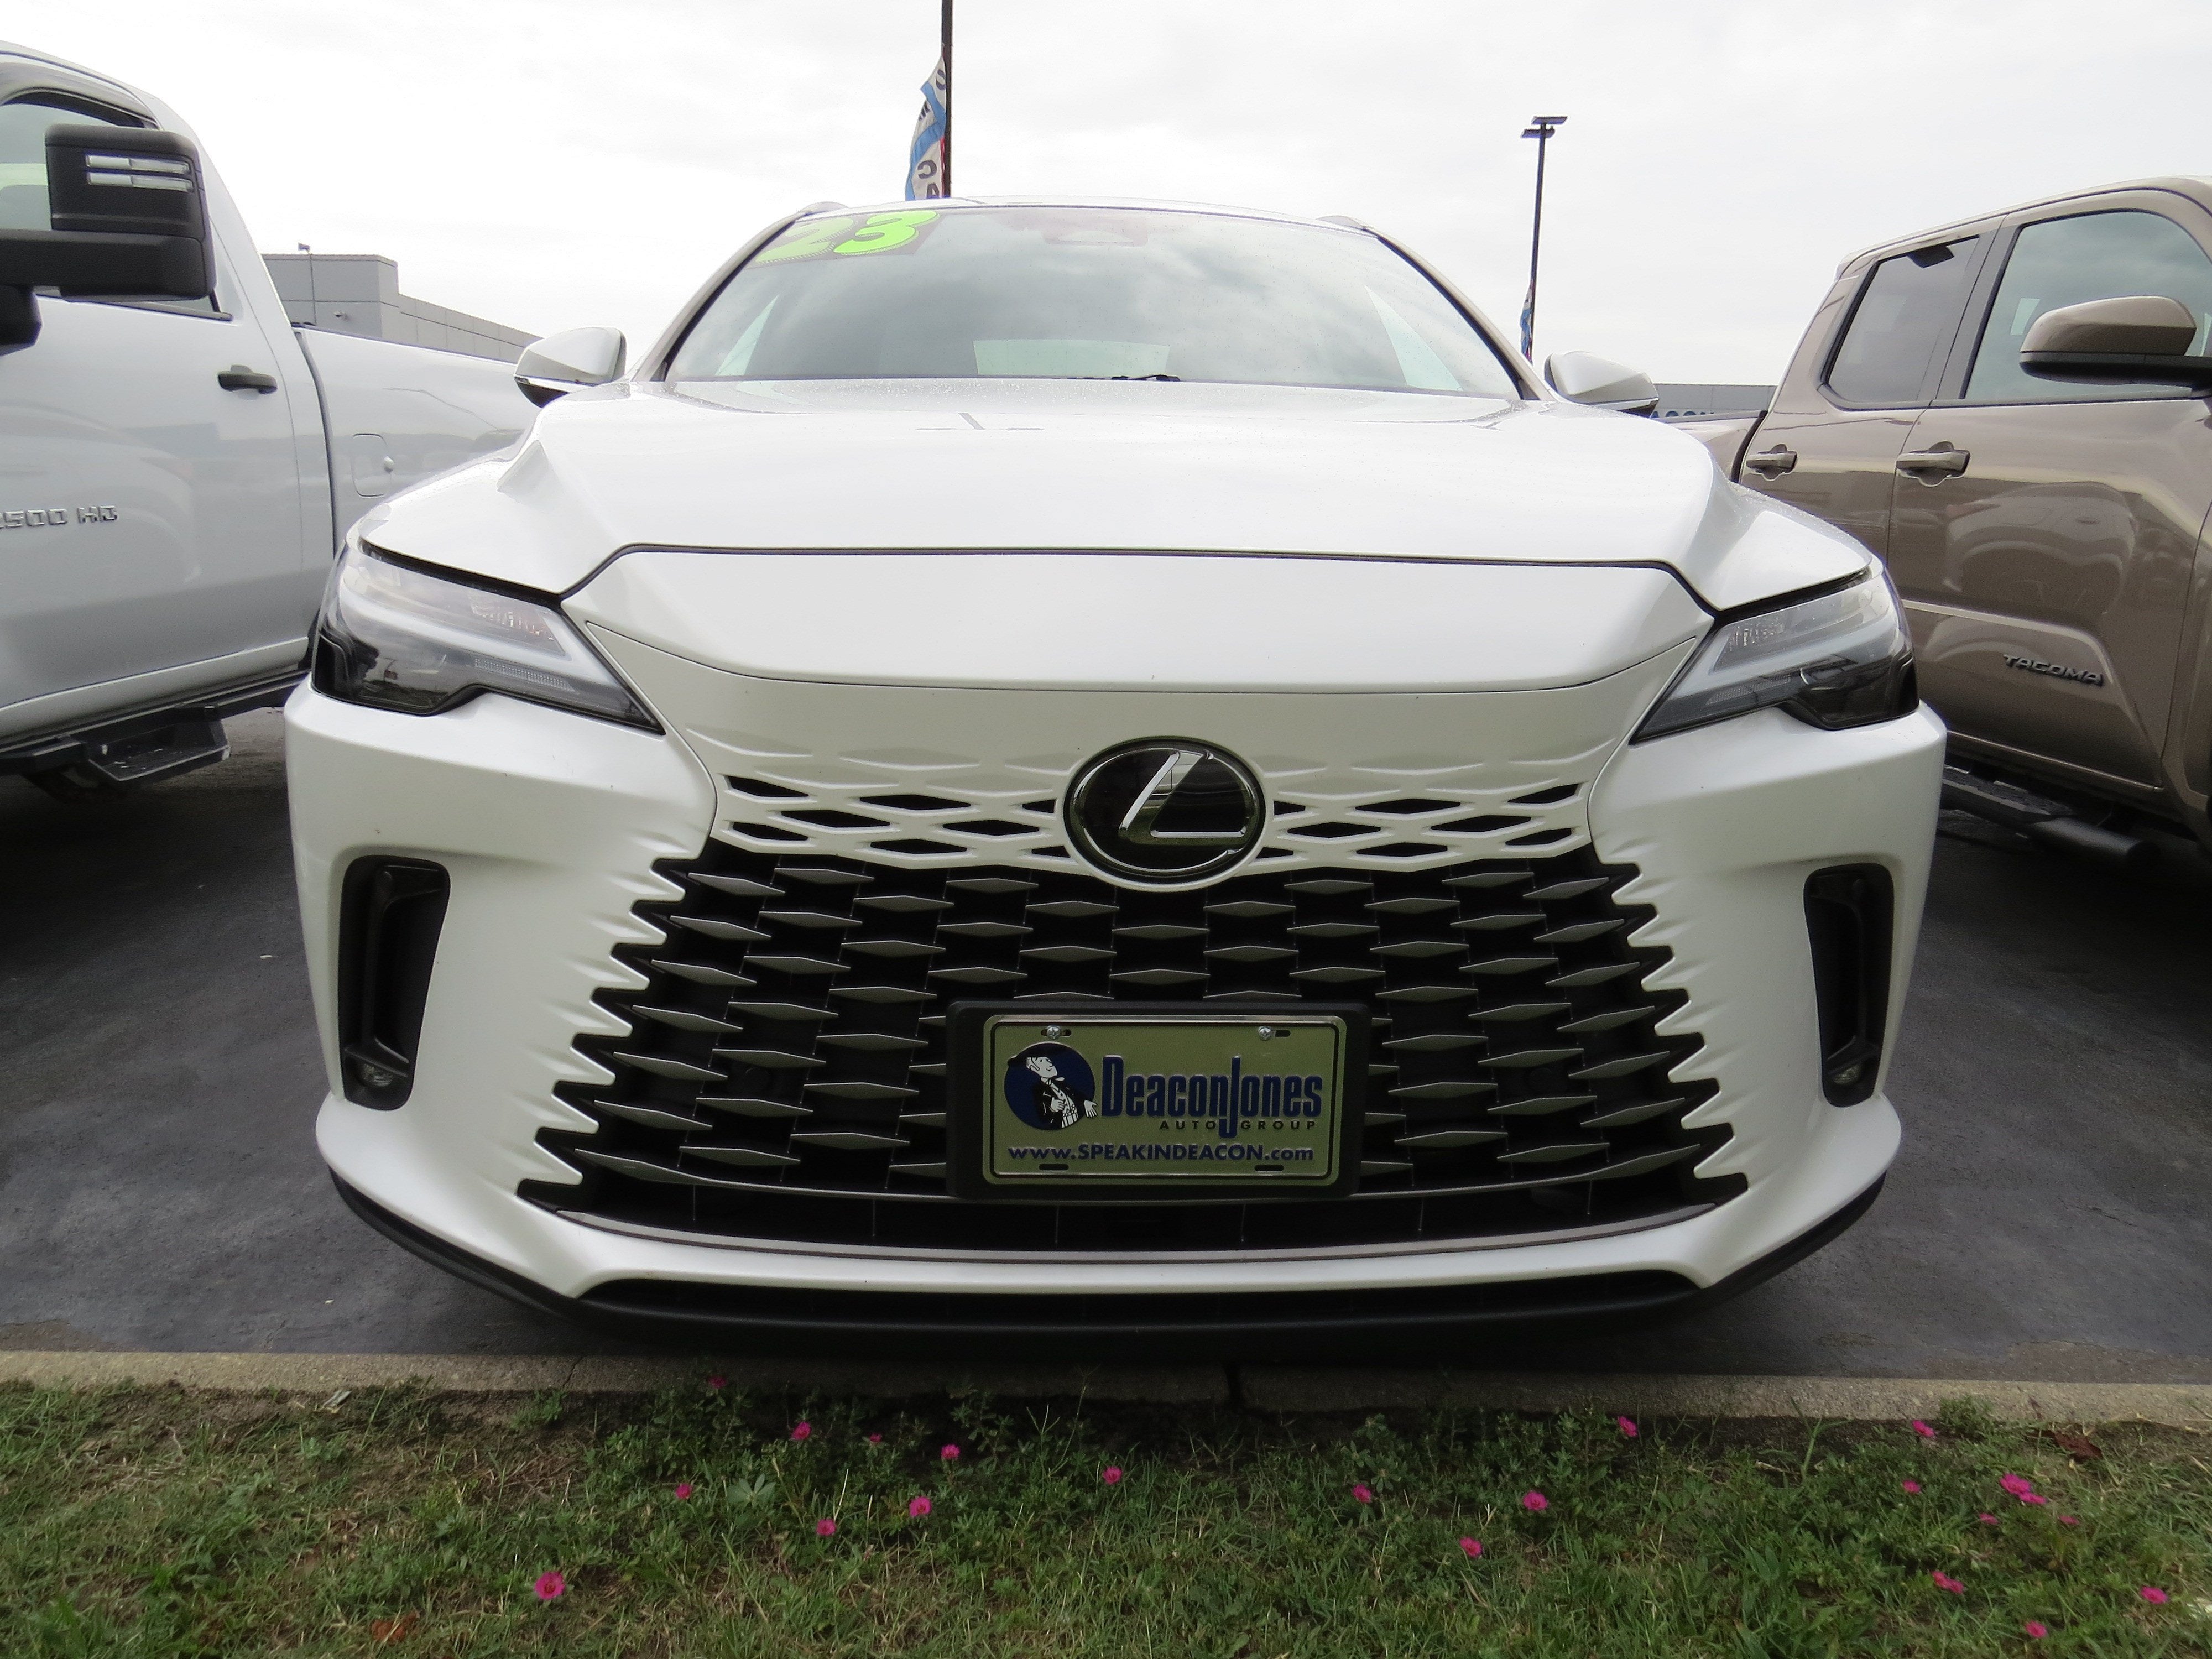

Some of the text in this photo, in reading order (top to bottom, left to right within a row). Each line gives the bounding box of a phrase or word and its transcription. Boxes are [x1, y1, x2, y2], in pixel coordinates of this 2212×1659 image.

[755, 210, 940, 264] 23
[0, 505, 118, 529] 500 HD
[2003, 654, 2105, 686] TACOMA
[1160, 1119, 1316, 1130] AUTO GROUP
[1008, 1143, 1314, 1161] www.SPEAKINDEACON.com
